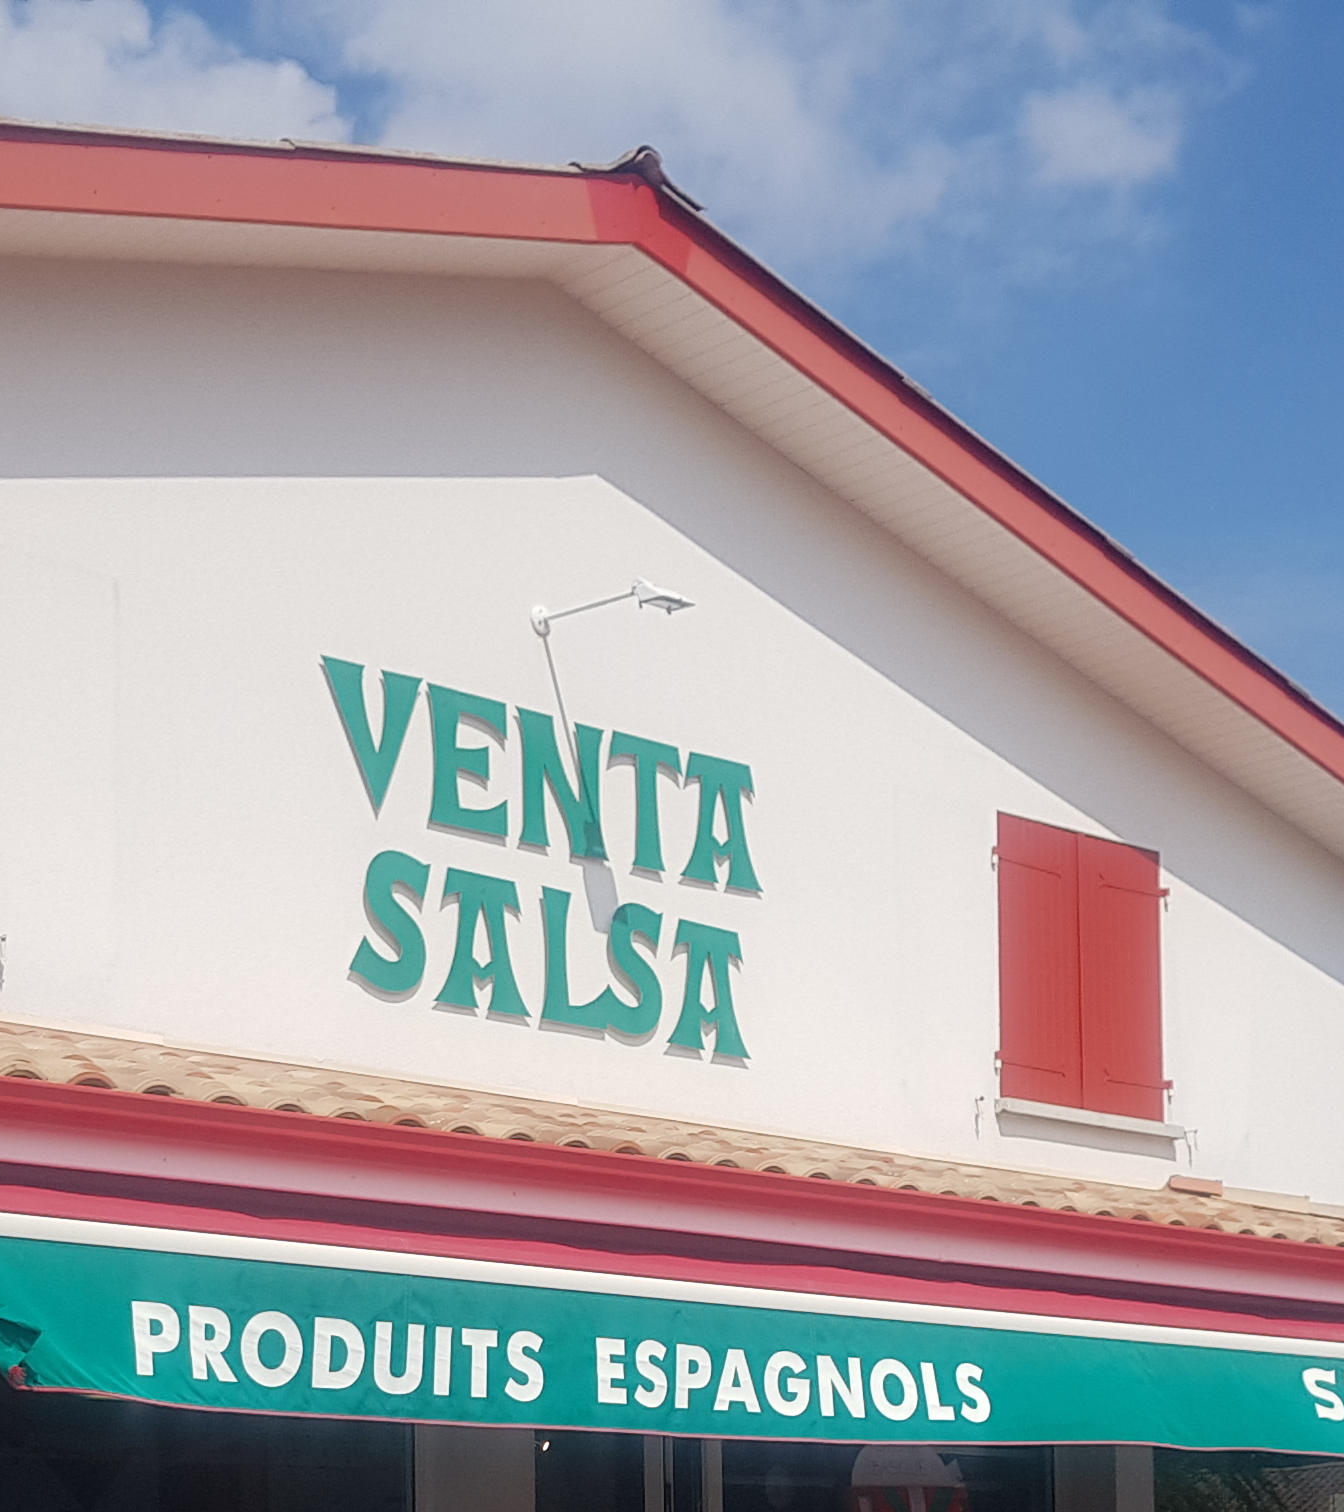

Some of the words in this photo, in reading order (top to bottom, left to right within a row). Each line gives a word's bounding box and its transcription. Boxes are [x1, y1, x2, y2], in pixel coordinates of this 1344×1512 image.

[319, 654, 764, 898] VENTA
[347, 850, 752, 1069] SALSA
[131, 1300, 544, 1402] PRODUITS
[595, 1336, 991, 1424] ESPAGNOLS
